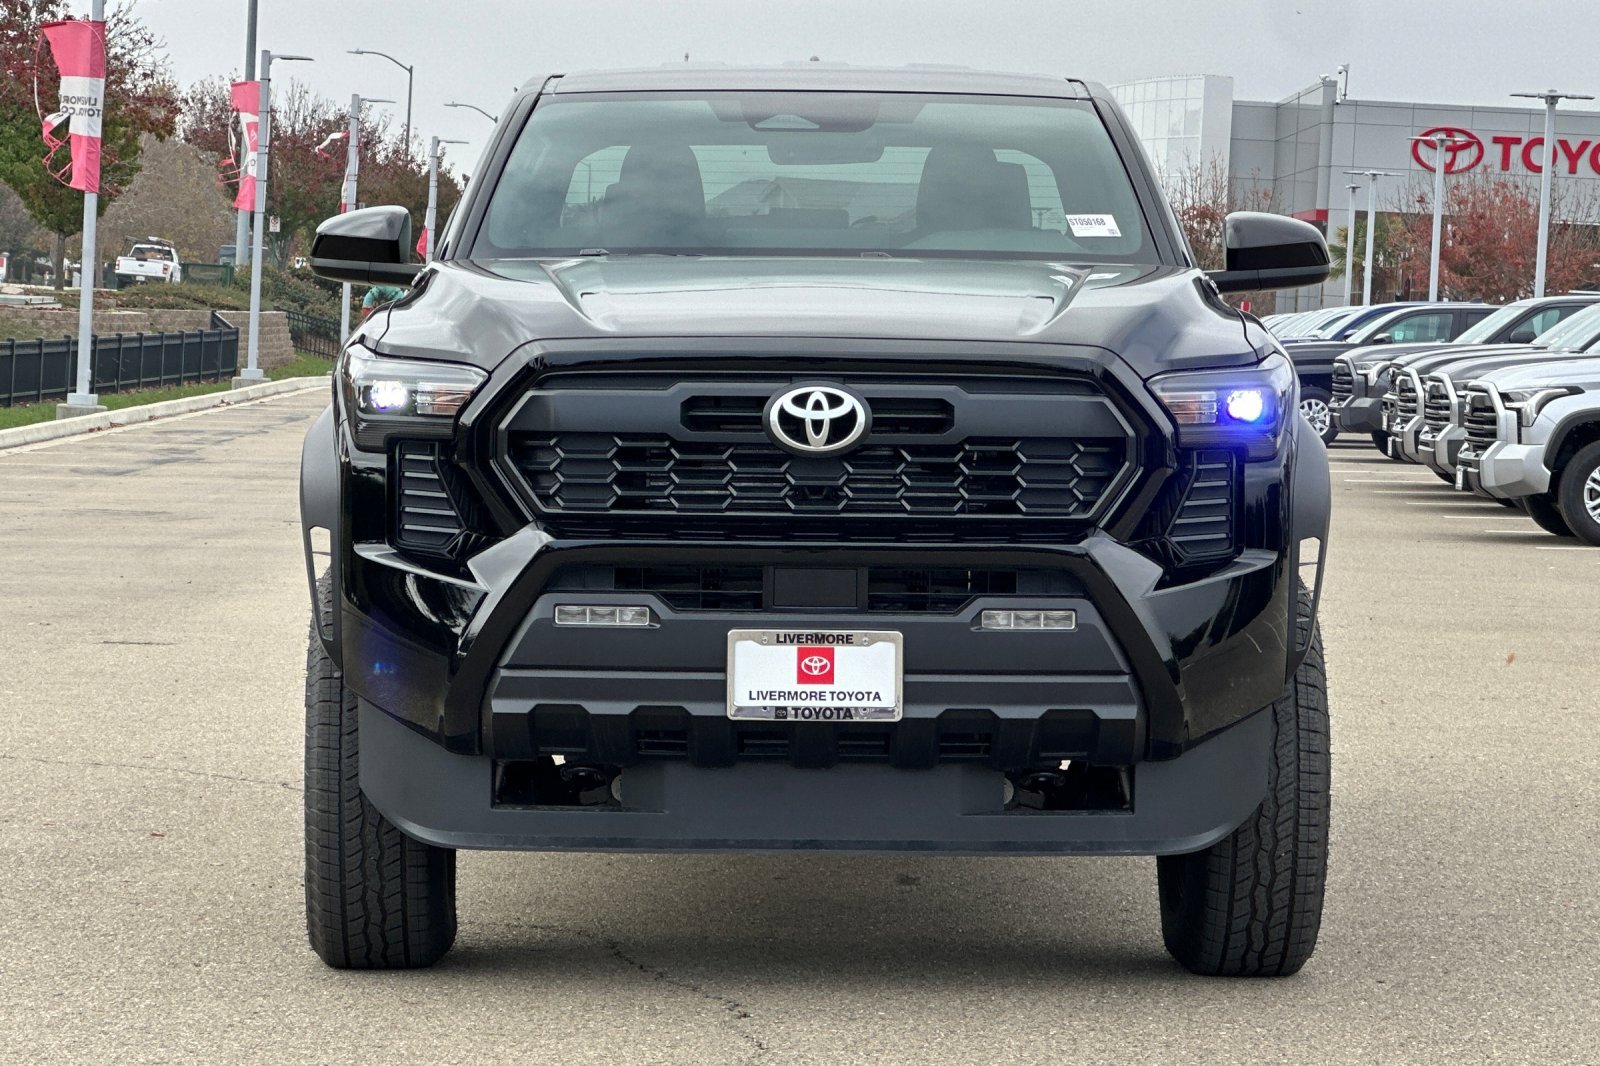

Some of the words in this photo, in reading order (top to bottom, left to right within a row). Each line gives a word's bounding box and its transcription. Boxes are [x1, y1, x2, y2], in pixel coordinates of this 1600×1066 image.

[776, 633, 854, 645] LIVERMORE
[749, 690, 827, 702] LIVERMORE
[829, 691, 882, 702] TOYOTA
[791, 707, 854, 720] TOYOTA
